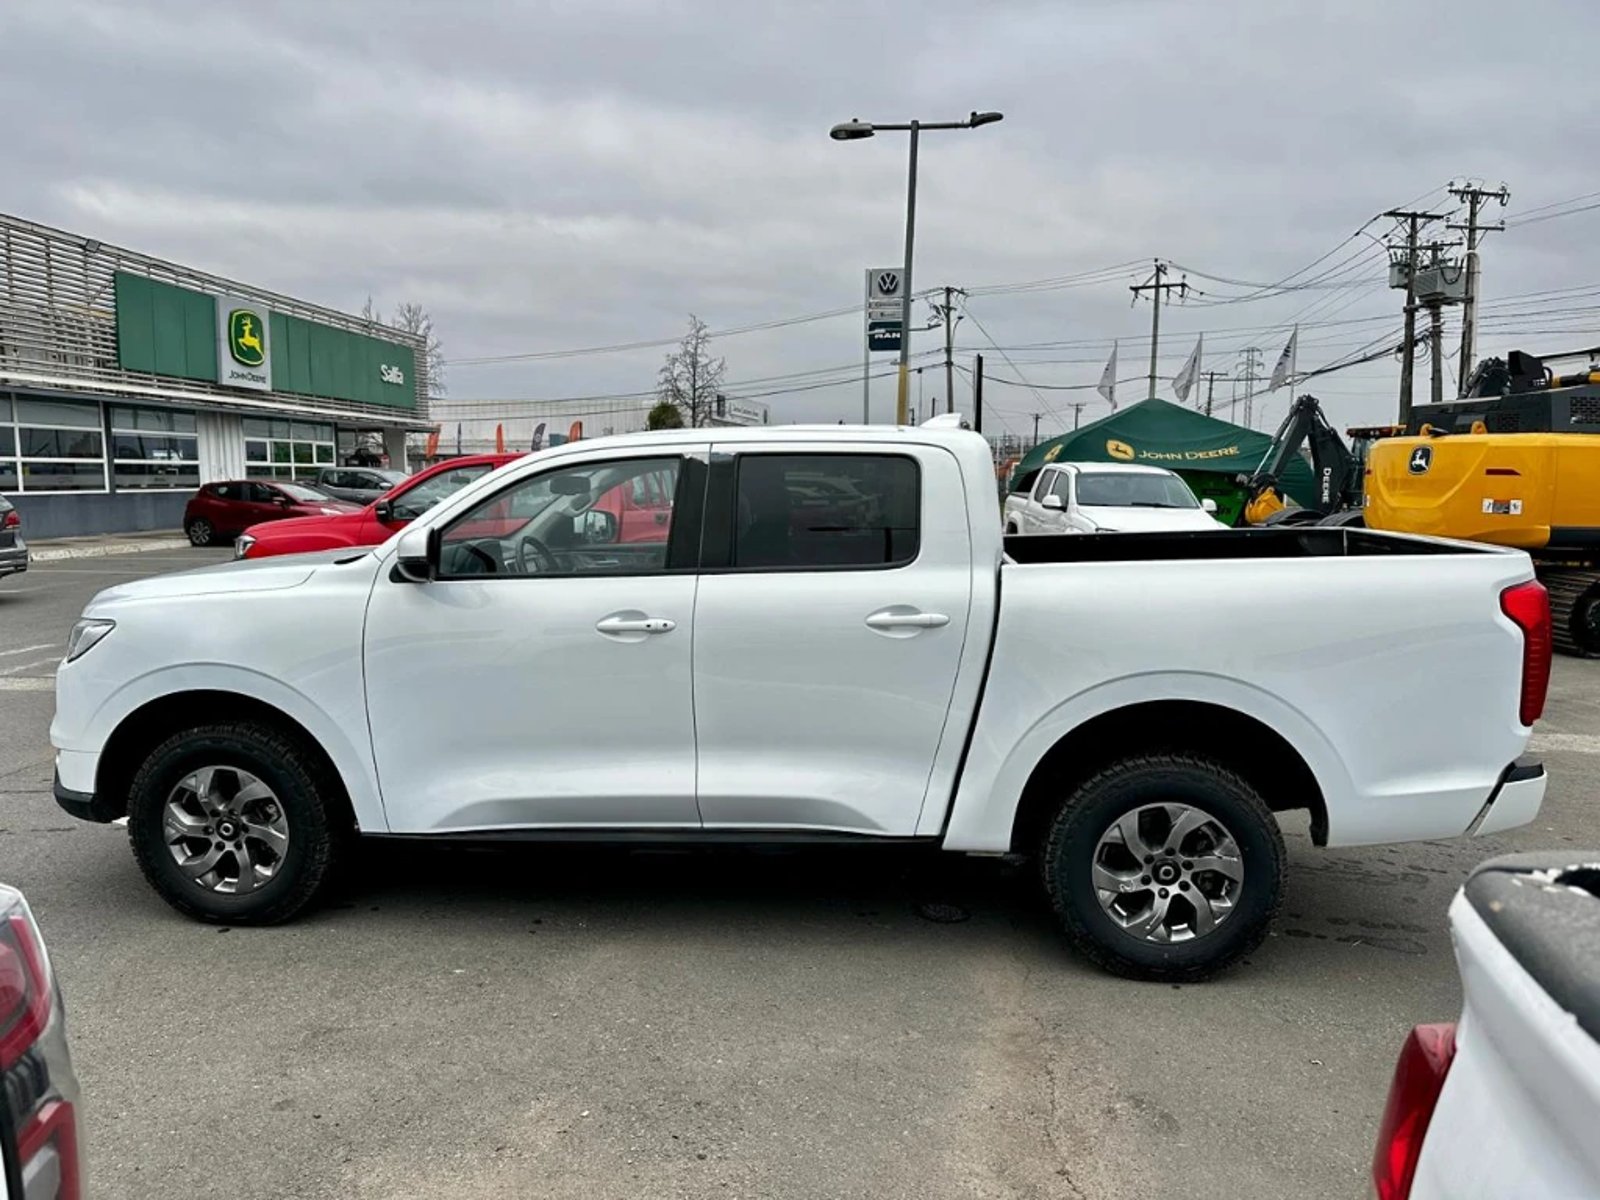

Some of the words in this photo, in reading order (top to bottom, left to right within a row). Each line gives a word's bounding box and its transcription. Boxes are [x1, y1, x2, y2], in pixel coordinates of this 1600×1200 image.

[1138, 450, 1182, 460] JOHN
[1185, 445, 1240, 460] DEERE
[1322, 467, 1332, 503] DEERE
